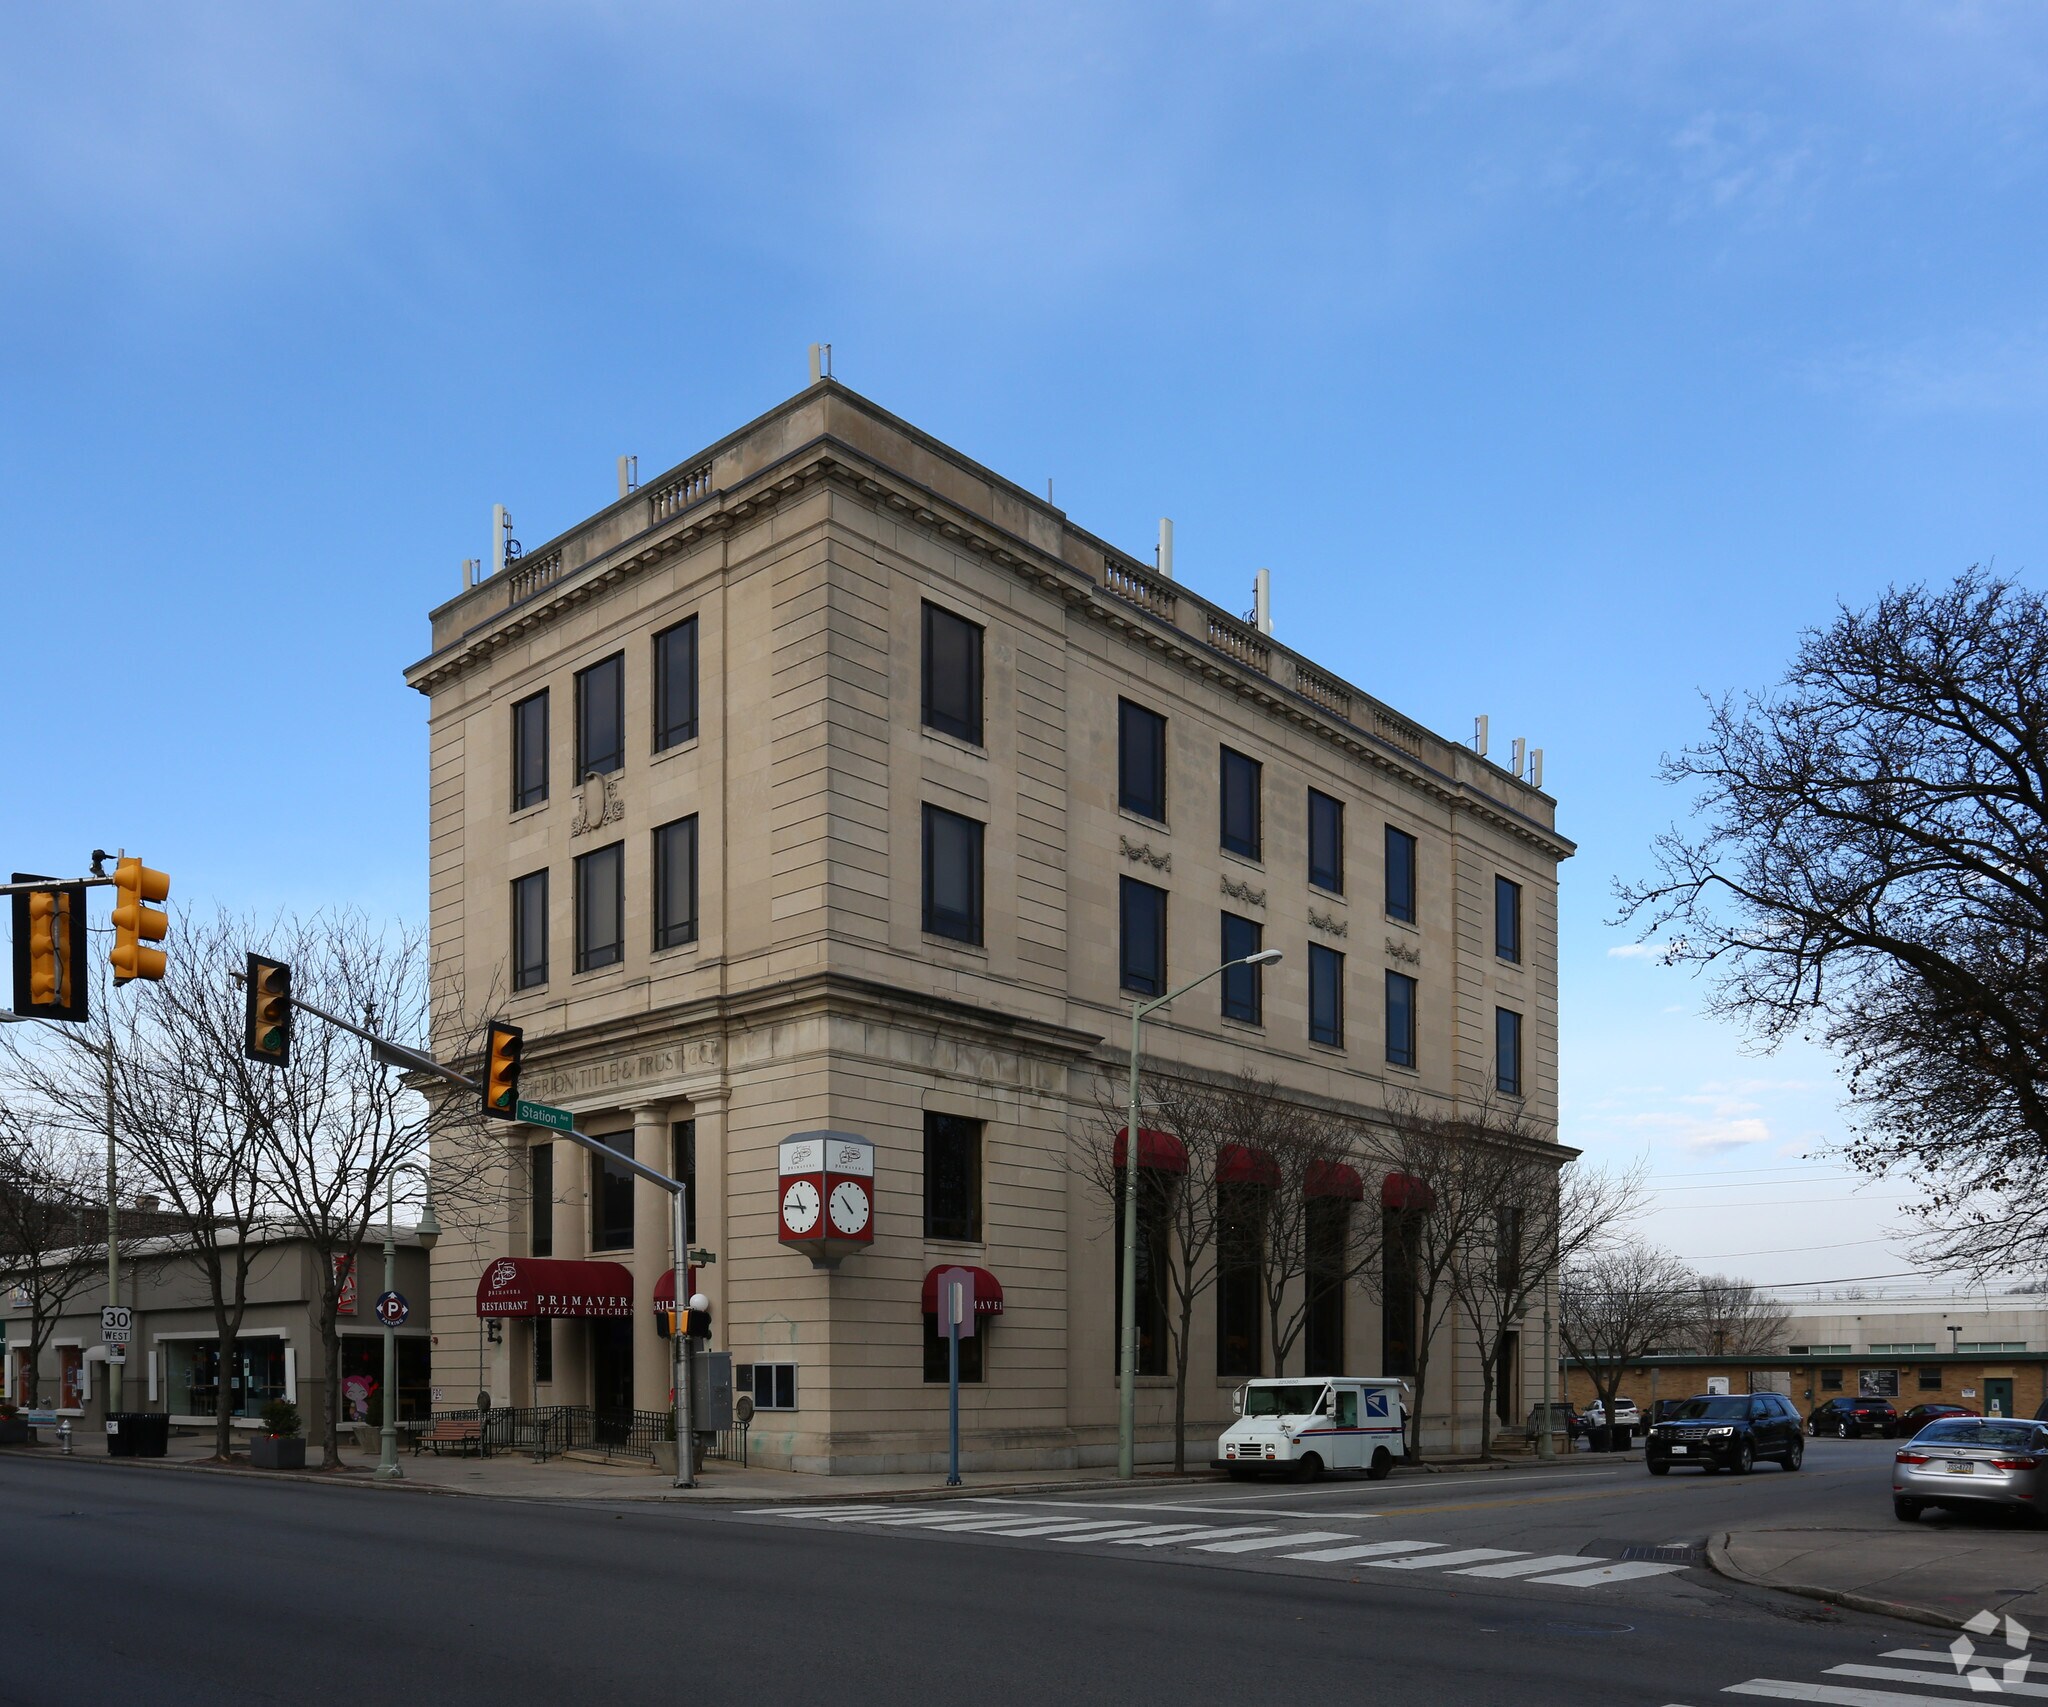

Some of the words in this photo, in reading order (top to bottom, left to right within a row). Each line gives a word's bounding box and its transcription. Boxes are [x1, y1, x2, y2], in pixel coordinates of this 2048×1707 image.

[579, 1064, 618, 1088] TITLE
[622, 1061, 632, 1079] &
[638, 1049, 682, 1077] TRUST
[521, 1106, 557, 1124] Station
[560, 1114, 569, 1122] Ave
[481, 1301, 528, 1312] RESTAURANT
[537, 1295, 633, 1307] PRIMAVER
[388, 1302, 399, 1317] P
[540, 1307, 576, 1315] PIZZA
[105, 1312, 128, 1327] 30
[381, 1317, 404, 1326] PARKING
[104, 1331, 128, 1340] WEST
